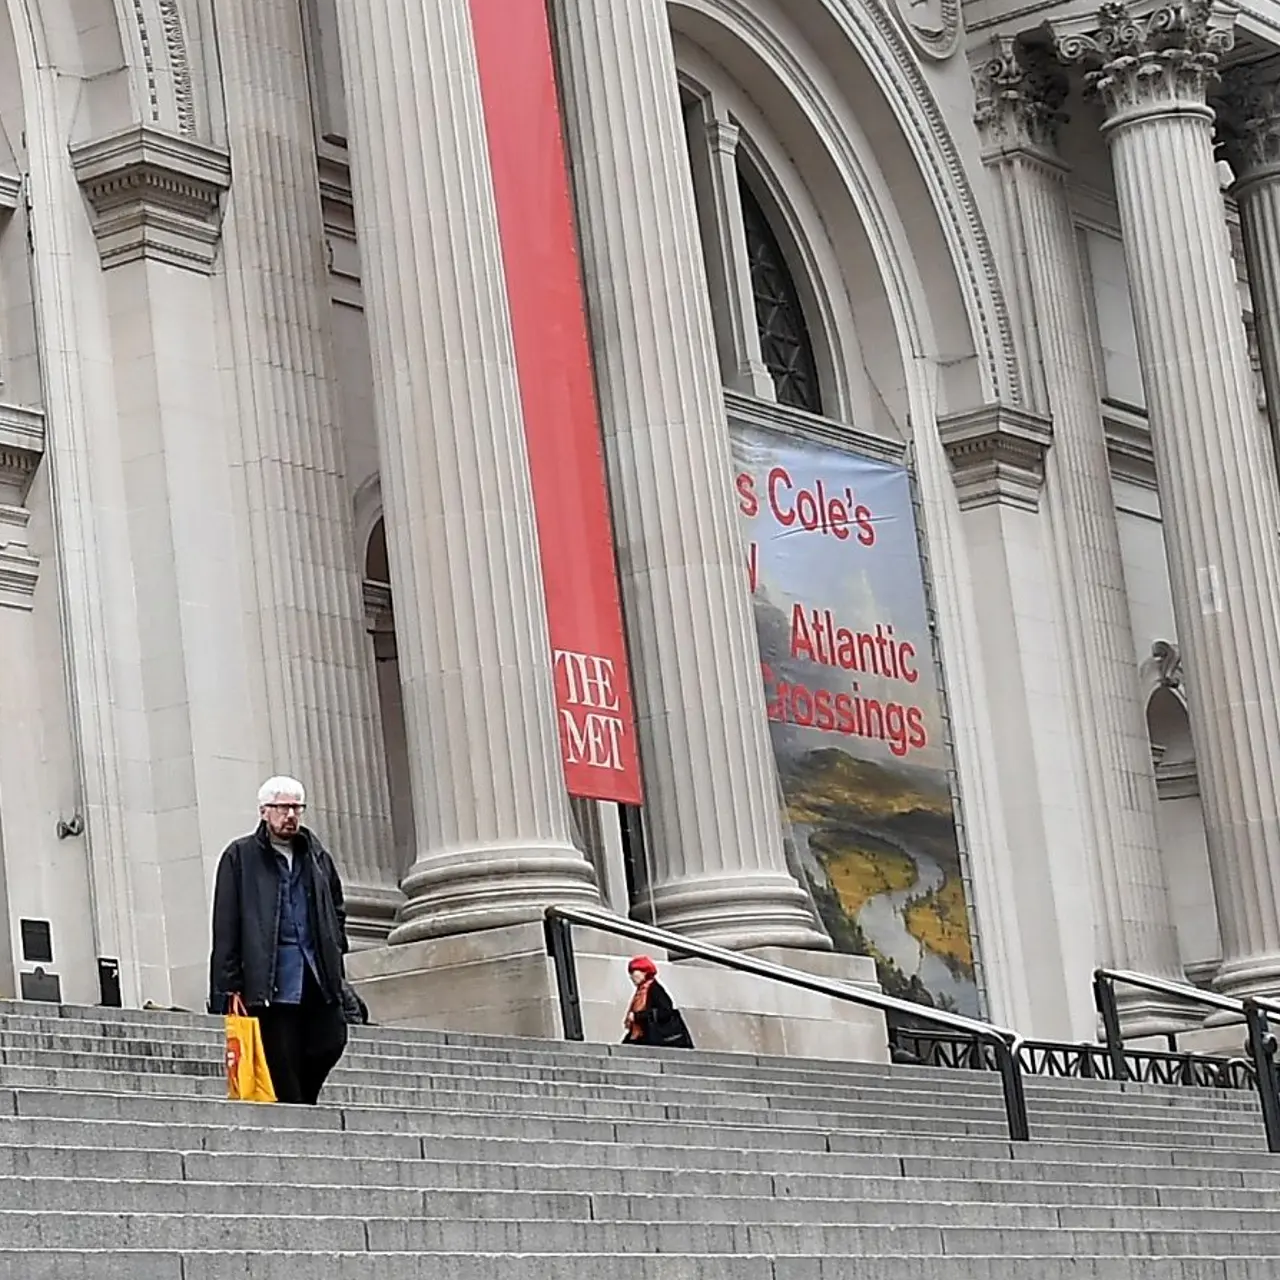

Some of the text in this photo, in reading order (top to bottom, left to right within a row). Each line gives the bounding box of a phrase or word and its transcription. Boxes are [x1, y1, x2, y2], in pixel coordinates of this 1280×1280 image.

[767, 466, 875, 547] Cole's
[791, 603, 918, 683] Atlantic
[554, 649, 619, 712] THE
[559, 709, 625, 771] MET
